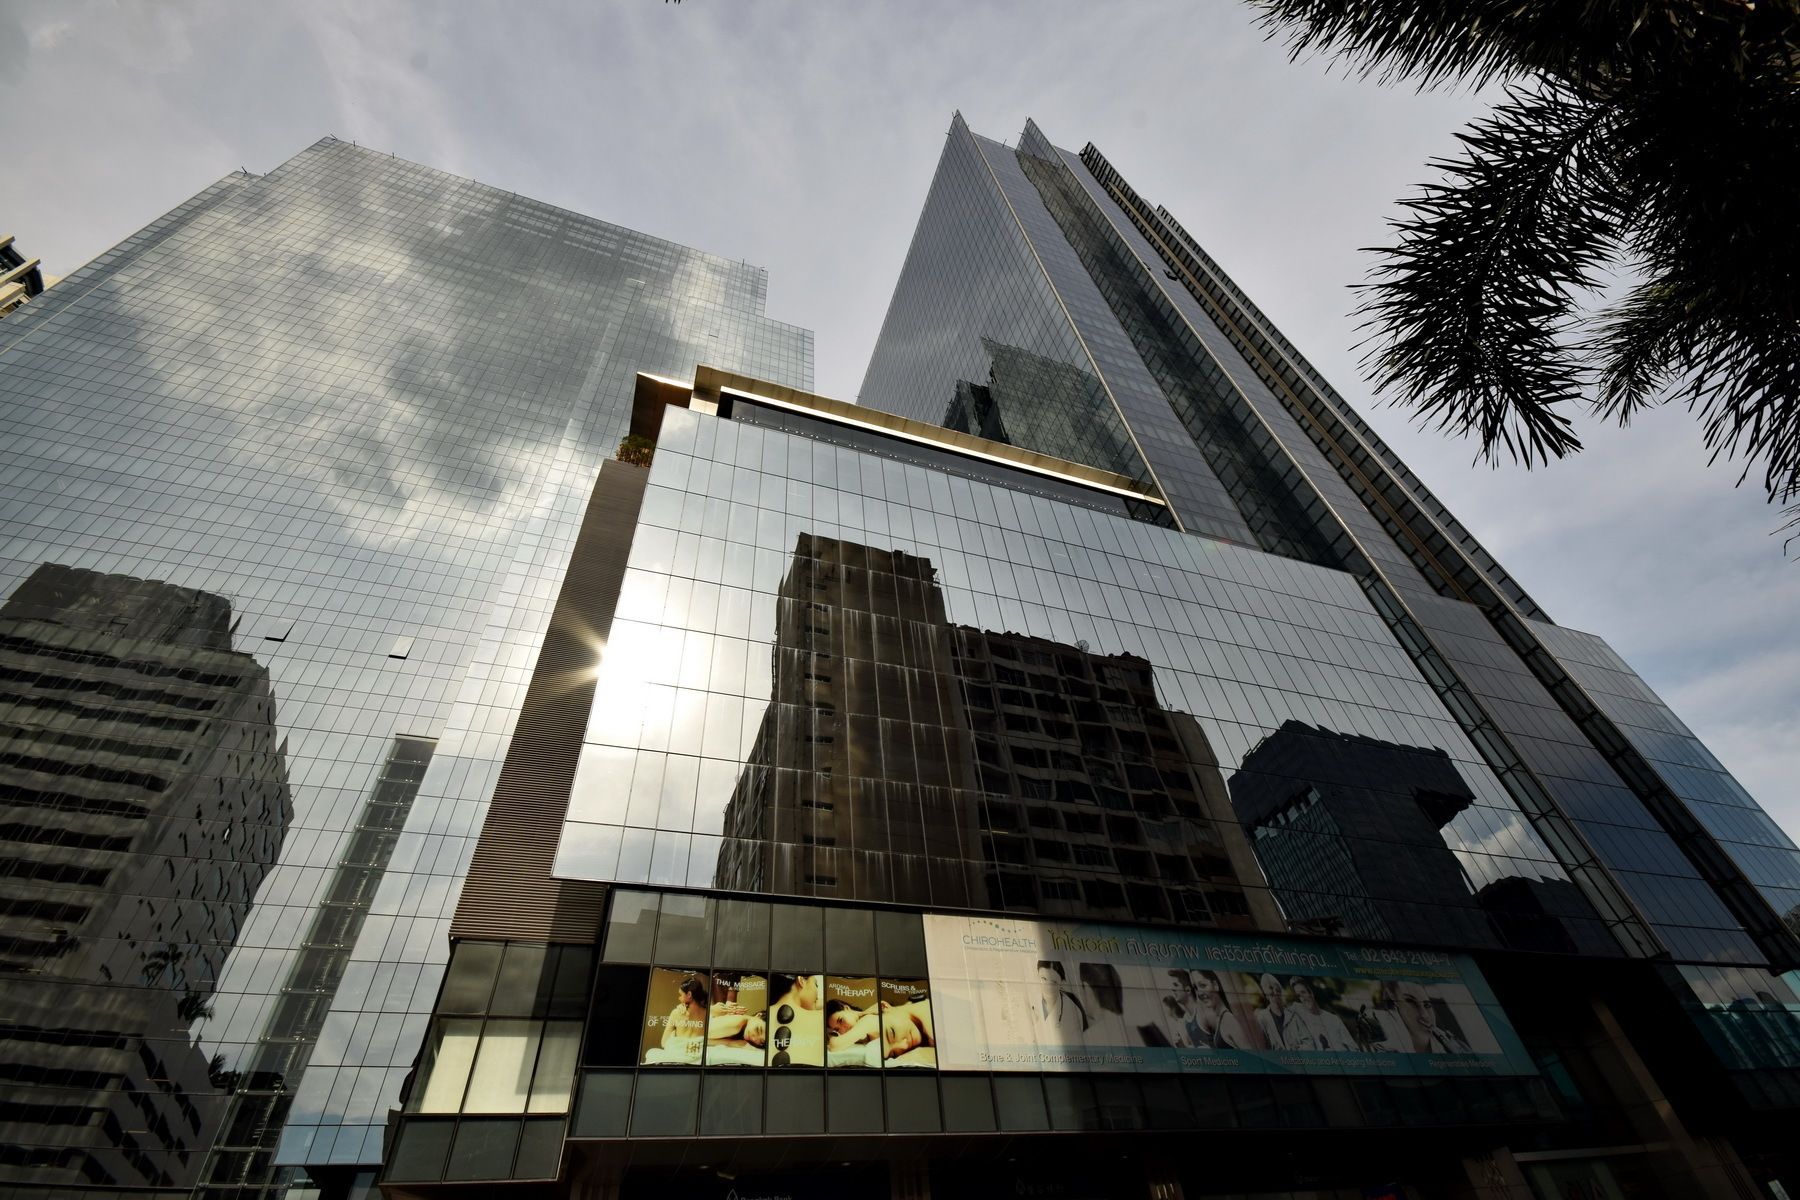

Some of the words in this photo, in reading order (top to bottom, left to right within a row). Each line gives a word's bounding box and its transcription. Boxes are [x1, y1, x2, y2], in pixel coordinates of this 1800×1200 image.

[962, 935, 1037, 948] CHIROHEALTH
[1360, 948, 1381, 962] 02
[715, 979, 731, 987] THAI
[733, 981, 766, 989] MASSAGE
[881, 982, 910, 991] SCRUBS
[836, 988, 875, 997] THERAPY
[648, 1019, 658, 1027] OF
[980, 1052, 1004, 1063] Bone
[1006, 1053, 1013, 1063] &
[1015, 1053, 1037, 1063] Joint
[1038, 1053, 1105, 1066] Complementary
[1105, 1055, 1144, 1065] Medicine
[1180, 1056, 1202, 1067] Sport
[1203, 1056, 1239, 1066] Medicine
